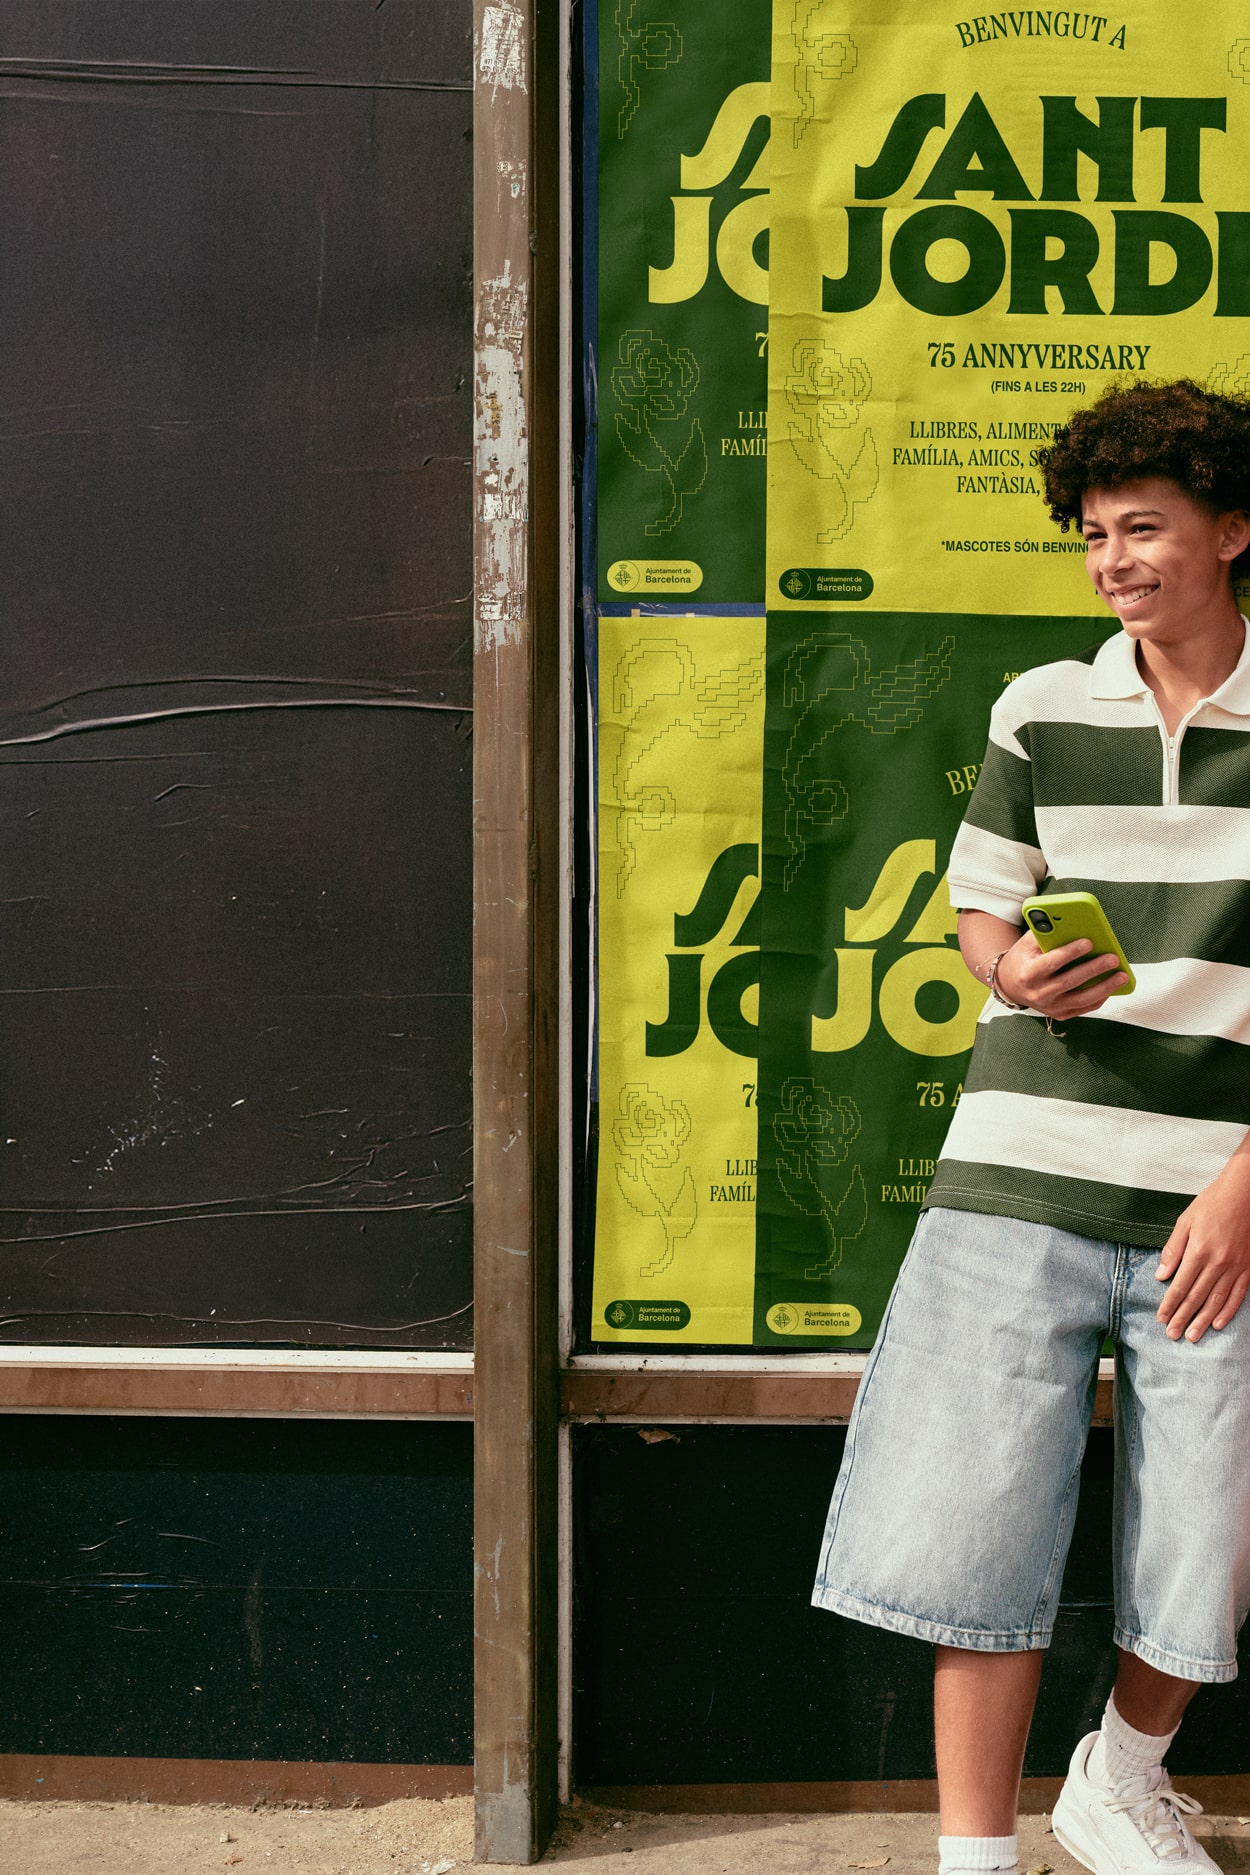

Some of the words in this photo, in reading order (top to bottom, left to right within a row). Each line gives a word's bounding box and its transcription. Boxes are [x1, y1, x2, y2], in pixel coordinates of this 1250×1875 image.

[955, 10, 1108, 48] BENVINGUT
[1108, 24, 1127, 50] A
[854, 91, 1228, 203] SANT
[927, 342, 956, 368] 75
[961, 343, 1152, 371] ANNYVERSARY
[990, 381, 1022, 393] (FINS
[1023, 382, 1033, 393] A
[1035, 382, 1058, 393] LES
[1060, 382, 1086, 395] 22H)
[910, 421, 982, 441] LLIBRES,
[892, 444, 964, 468] FAMÍLIA,
[967, 448, 1025, 469] AMICS,
[957, 471, 1041, 497] FANTÀSIA,
[1014, 538, 1039, 553] SÓN
[1042, 541, 1089, 553] BENVIN
[645, 567, 682, 575] Ajuntament
[645, 575, 692, 584] Barcelona
[817, 575, 854, 583] Ajuntament
[816, 583, 862, 592] Barcelona
[916, 1081, 945, 1108] 75
[639, 1306, 672, 1314] Ajuntament
[805, 1310, 841, 1318] Ajuntament
[638, 1313, 681, 1322] Barcelona
[804, 1317, 850, 1327] Barcelona
